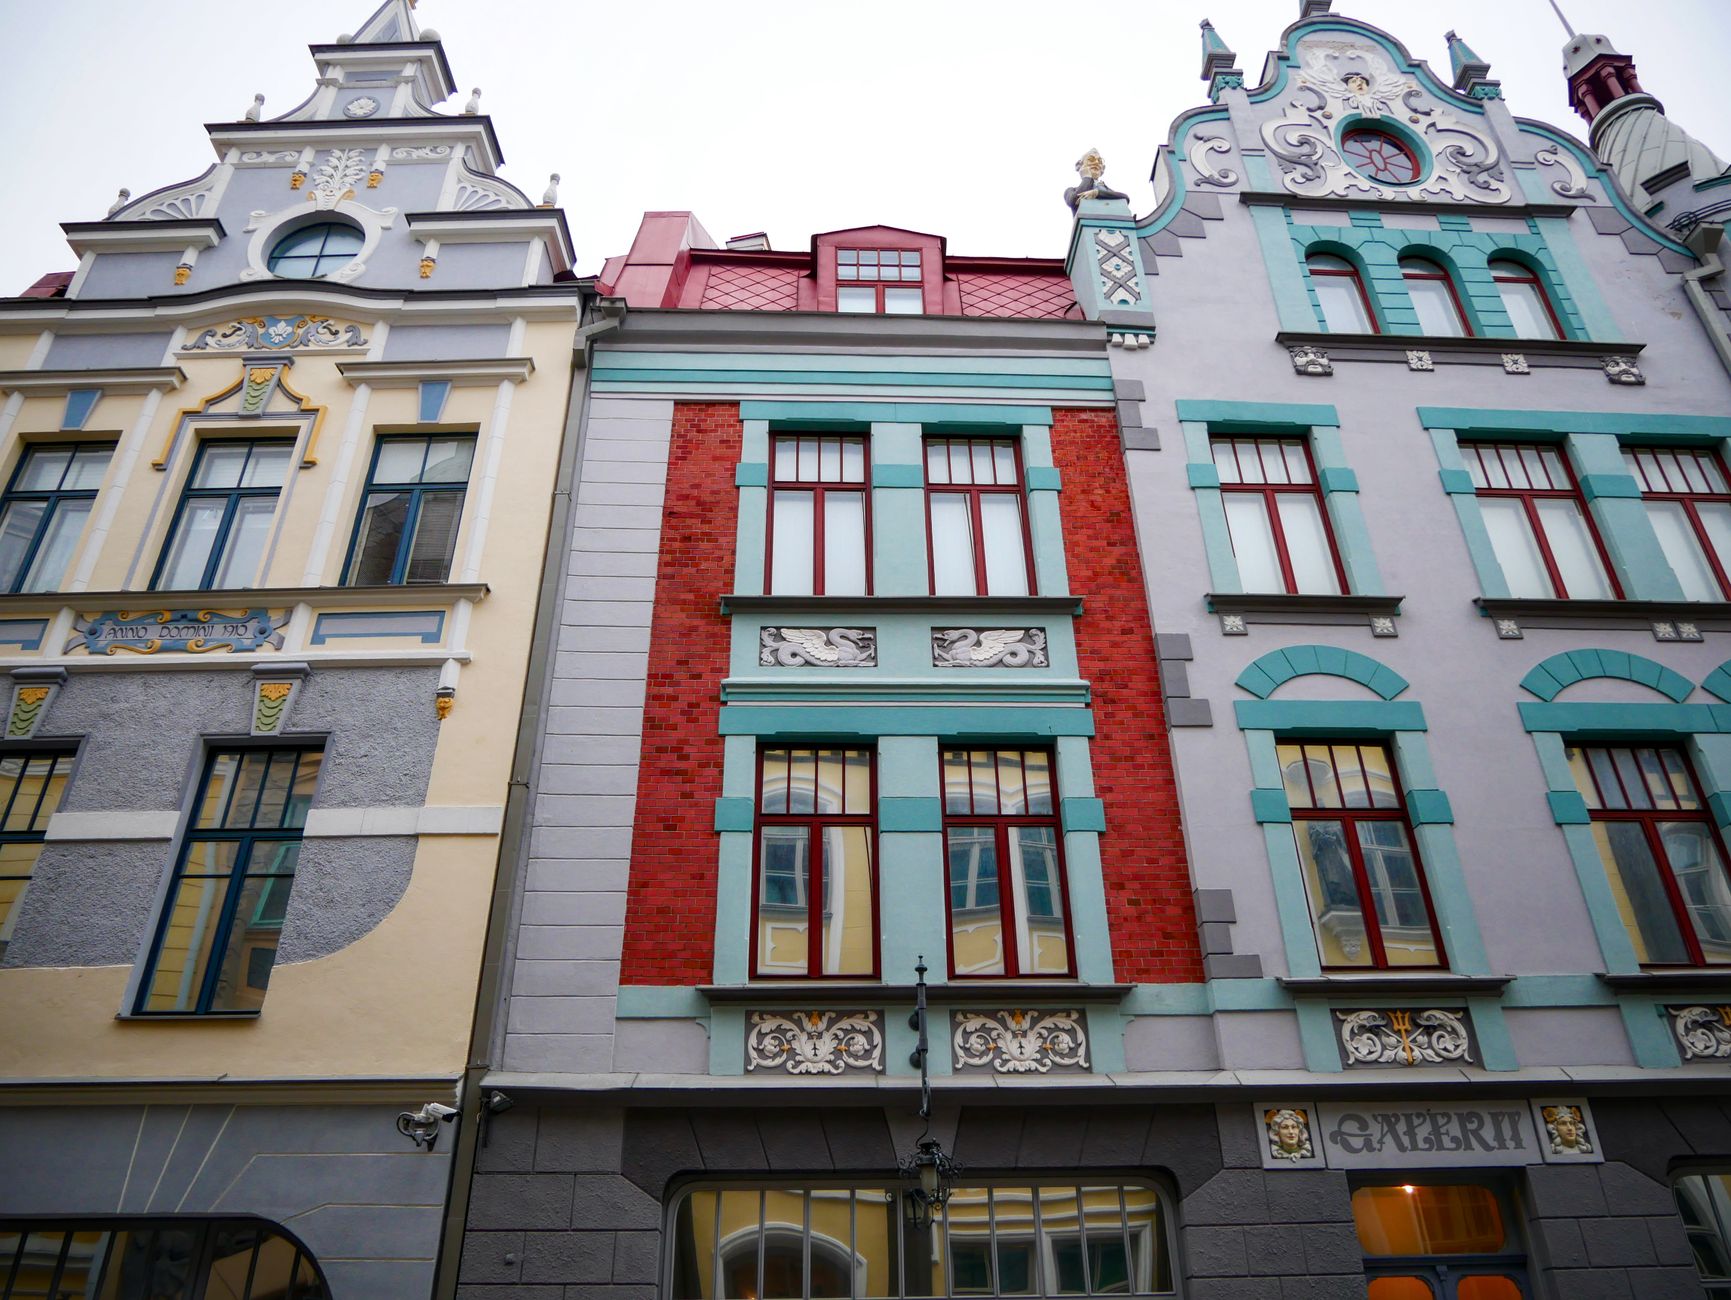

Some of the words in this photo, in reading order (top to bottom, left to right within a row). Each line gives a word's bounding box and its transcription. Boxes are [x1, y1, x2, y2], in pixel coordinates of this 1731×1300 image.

[104, 626, 148, 639] ANNO
[158, 625, 215, 638] DOMINI
[222, 624, 248, 637] 1910
[1328, 1111, 1527, 1154] GALERII
